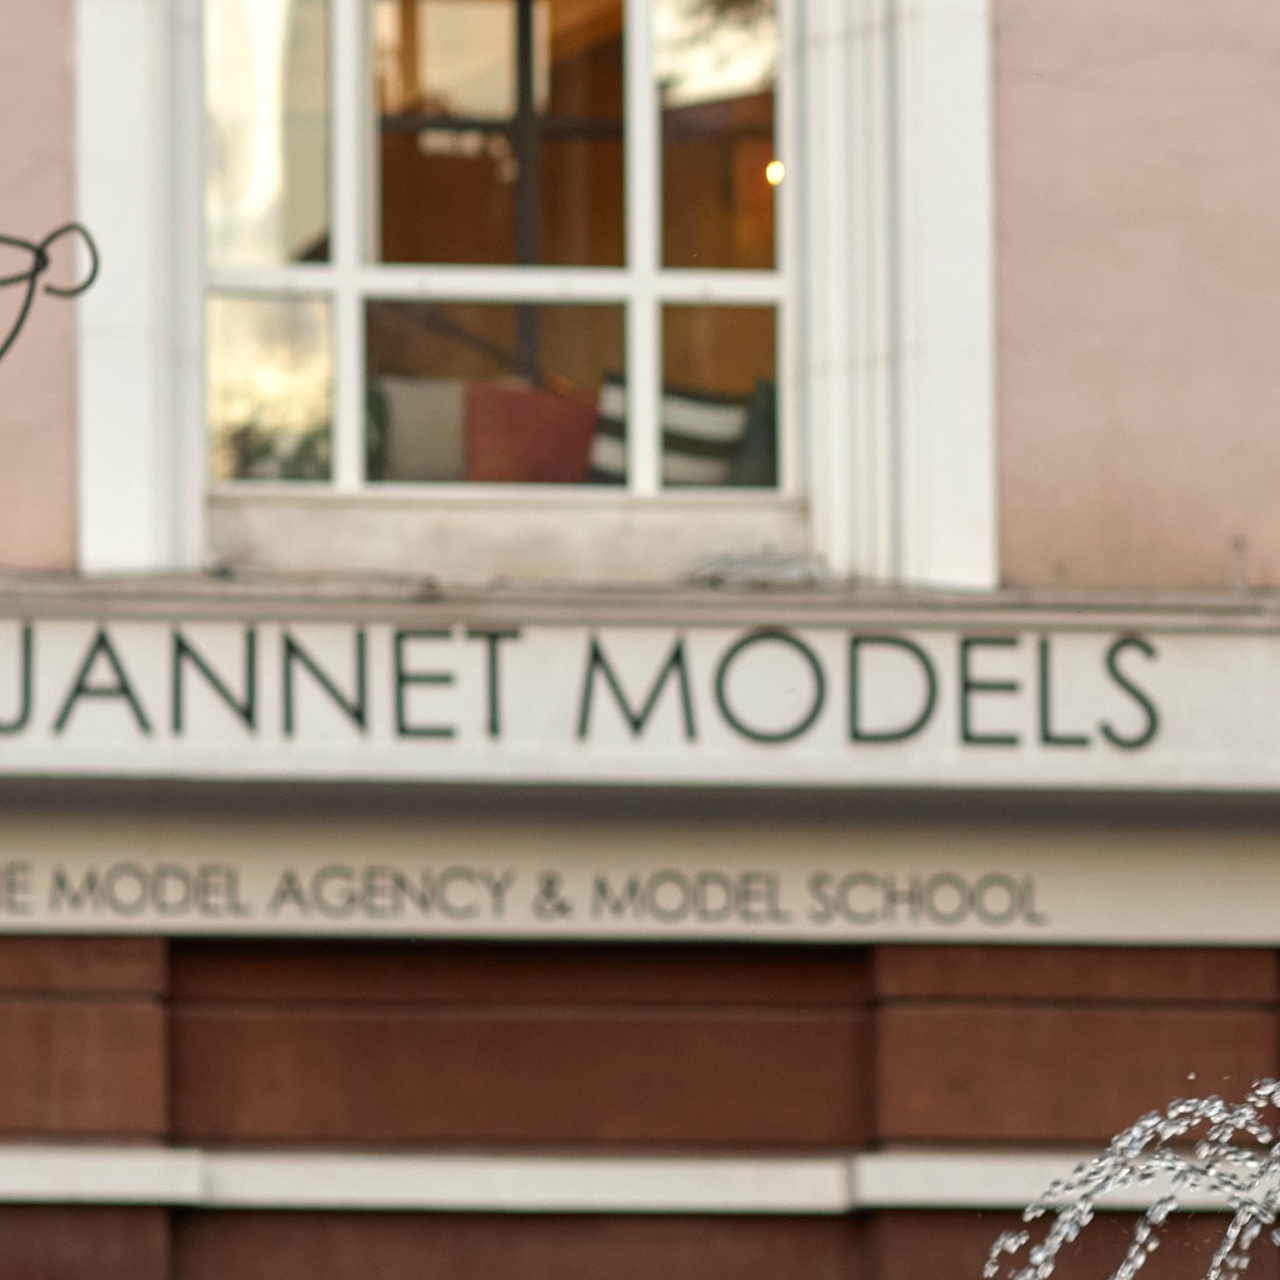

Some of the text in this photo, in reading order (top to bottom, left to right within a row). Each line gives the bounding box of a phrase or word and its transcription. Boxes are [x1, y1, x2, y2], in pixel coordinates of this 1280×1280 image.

[0, 622, 1161, 750] JANNET MODELS
[50, 860, 251, 918] MODEL
[271, 863, 516, 920] AGENCY
[533, 870, 574, 920] &
[590, 869, 787, 923] MODEL
[806, 870, 1047, 926] SCHOOL
